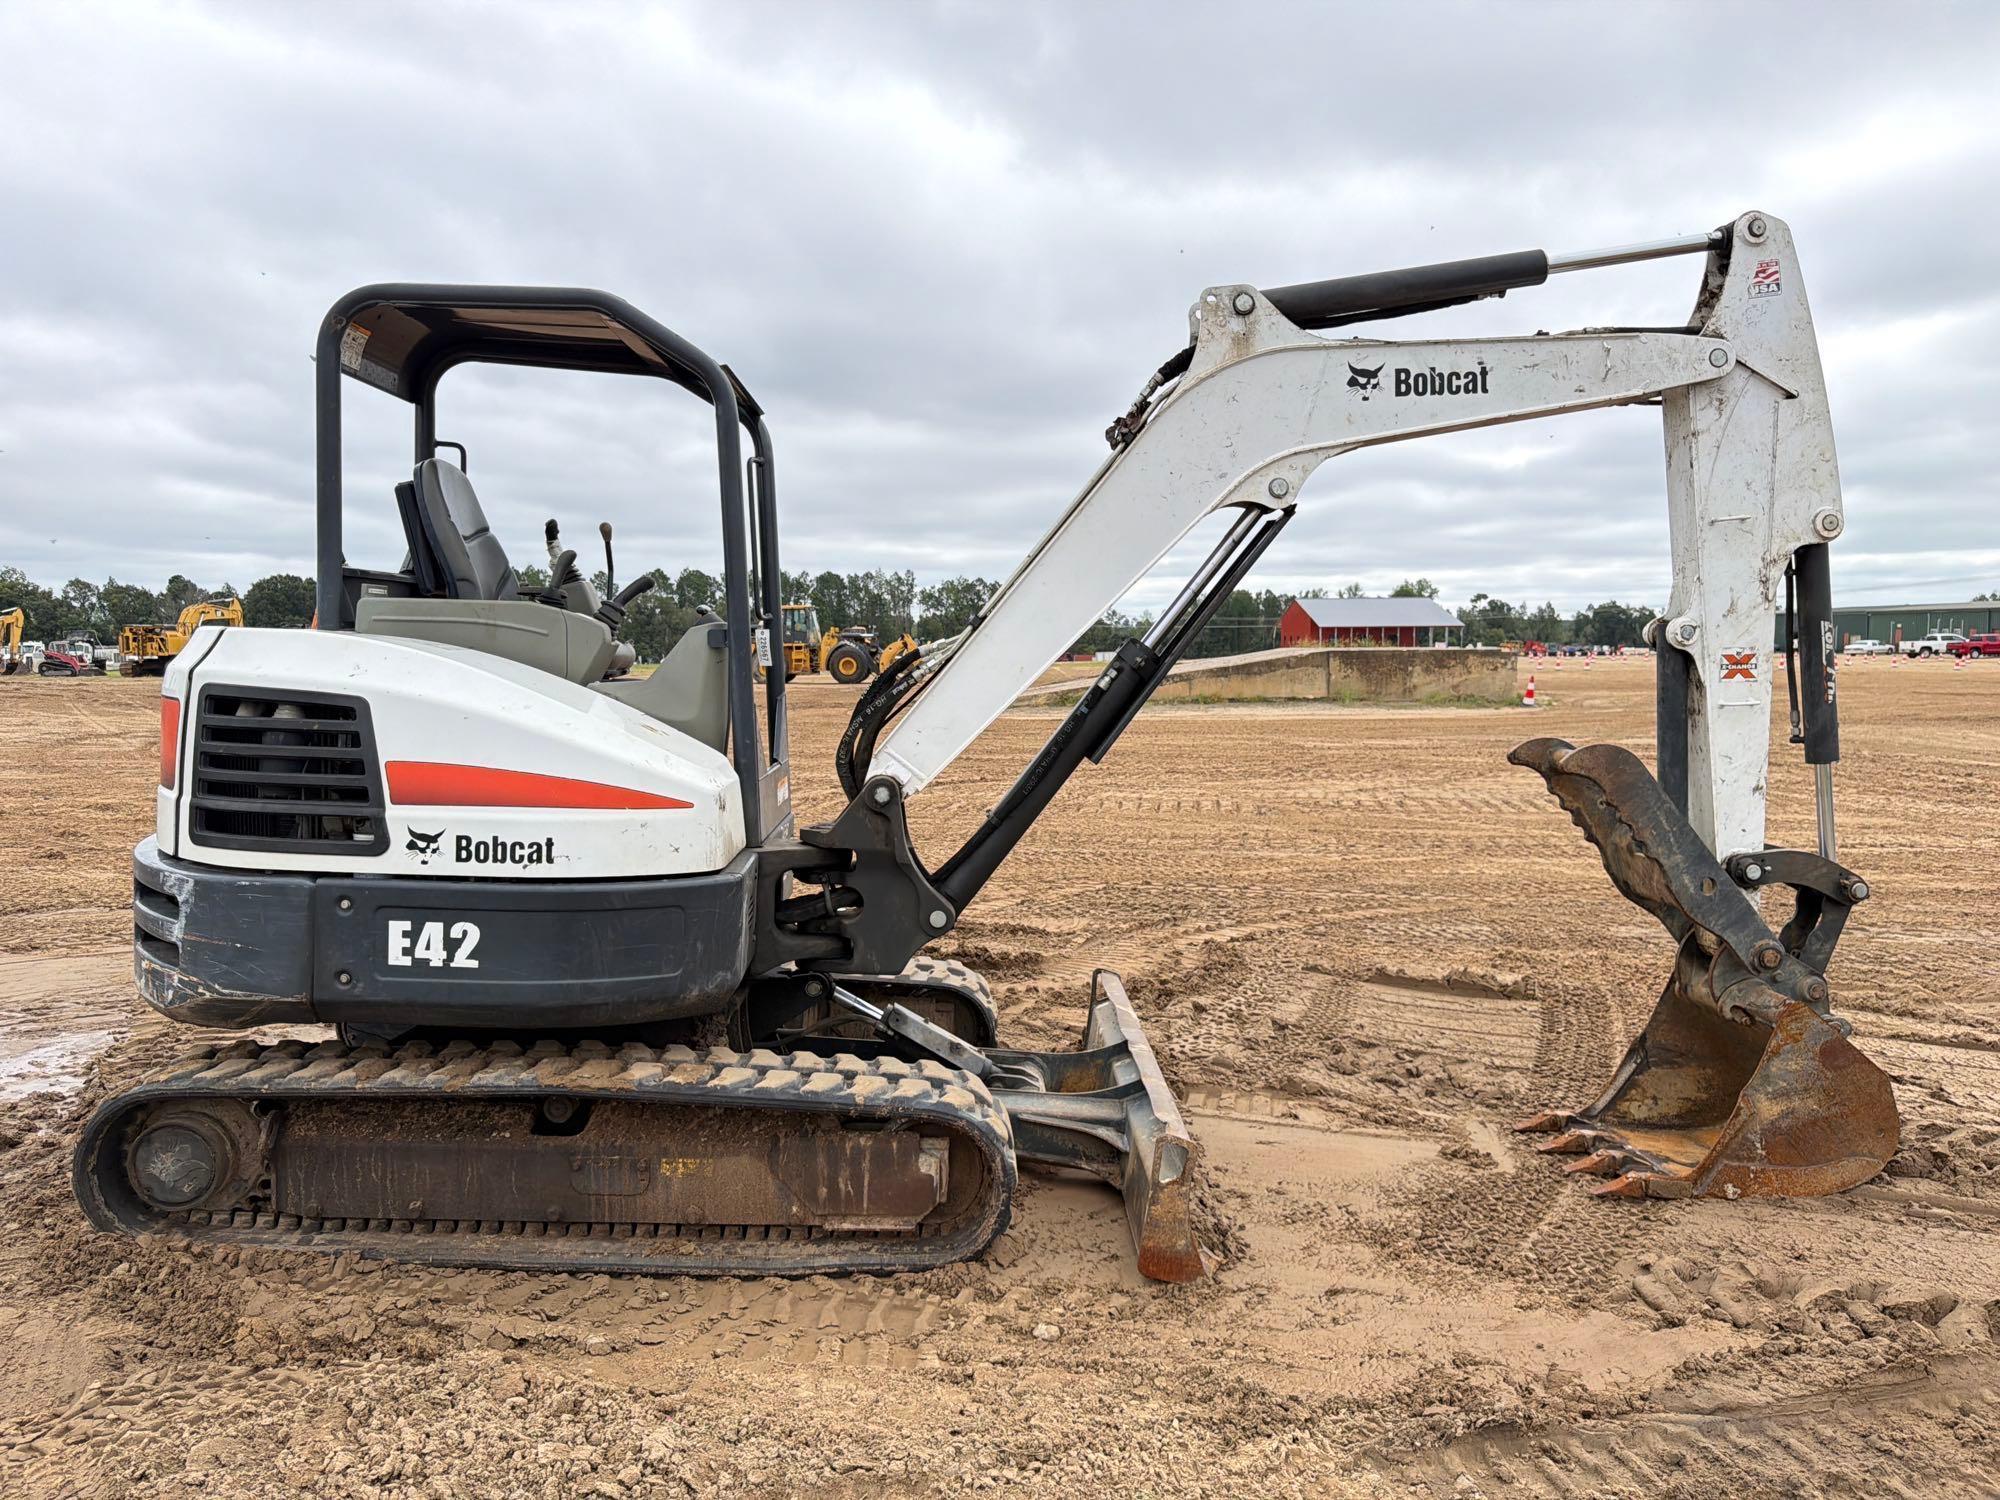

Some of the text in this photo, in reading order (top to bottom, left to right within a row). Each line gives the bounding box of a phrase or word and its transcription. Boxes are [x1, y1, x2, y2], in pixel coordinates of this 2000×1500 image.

[1751, 283, 1779, 294] USA
[1394, 366, 1489, 397] Bobcat
[455, 834, 555, 865] Bobcat
[388, 920, 481, 969] E42
